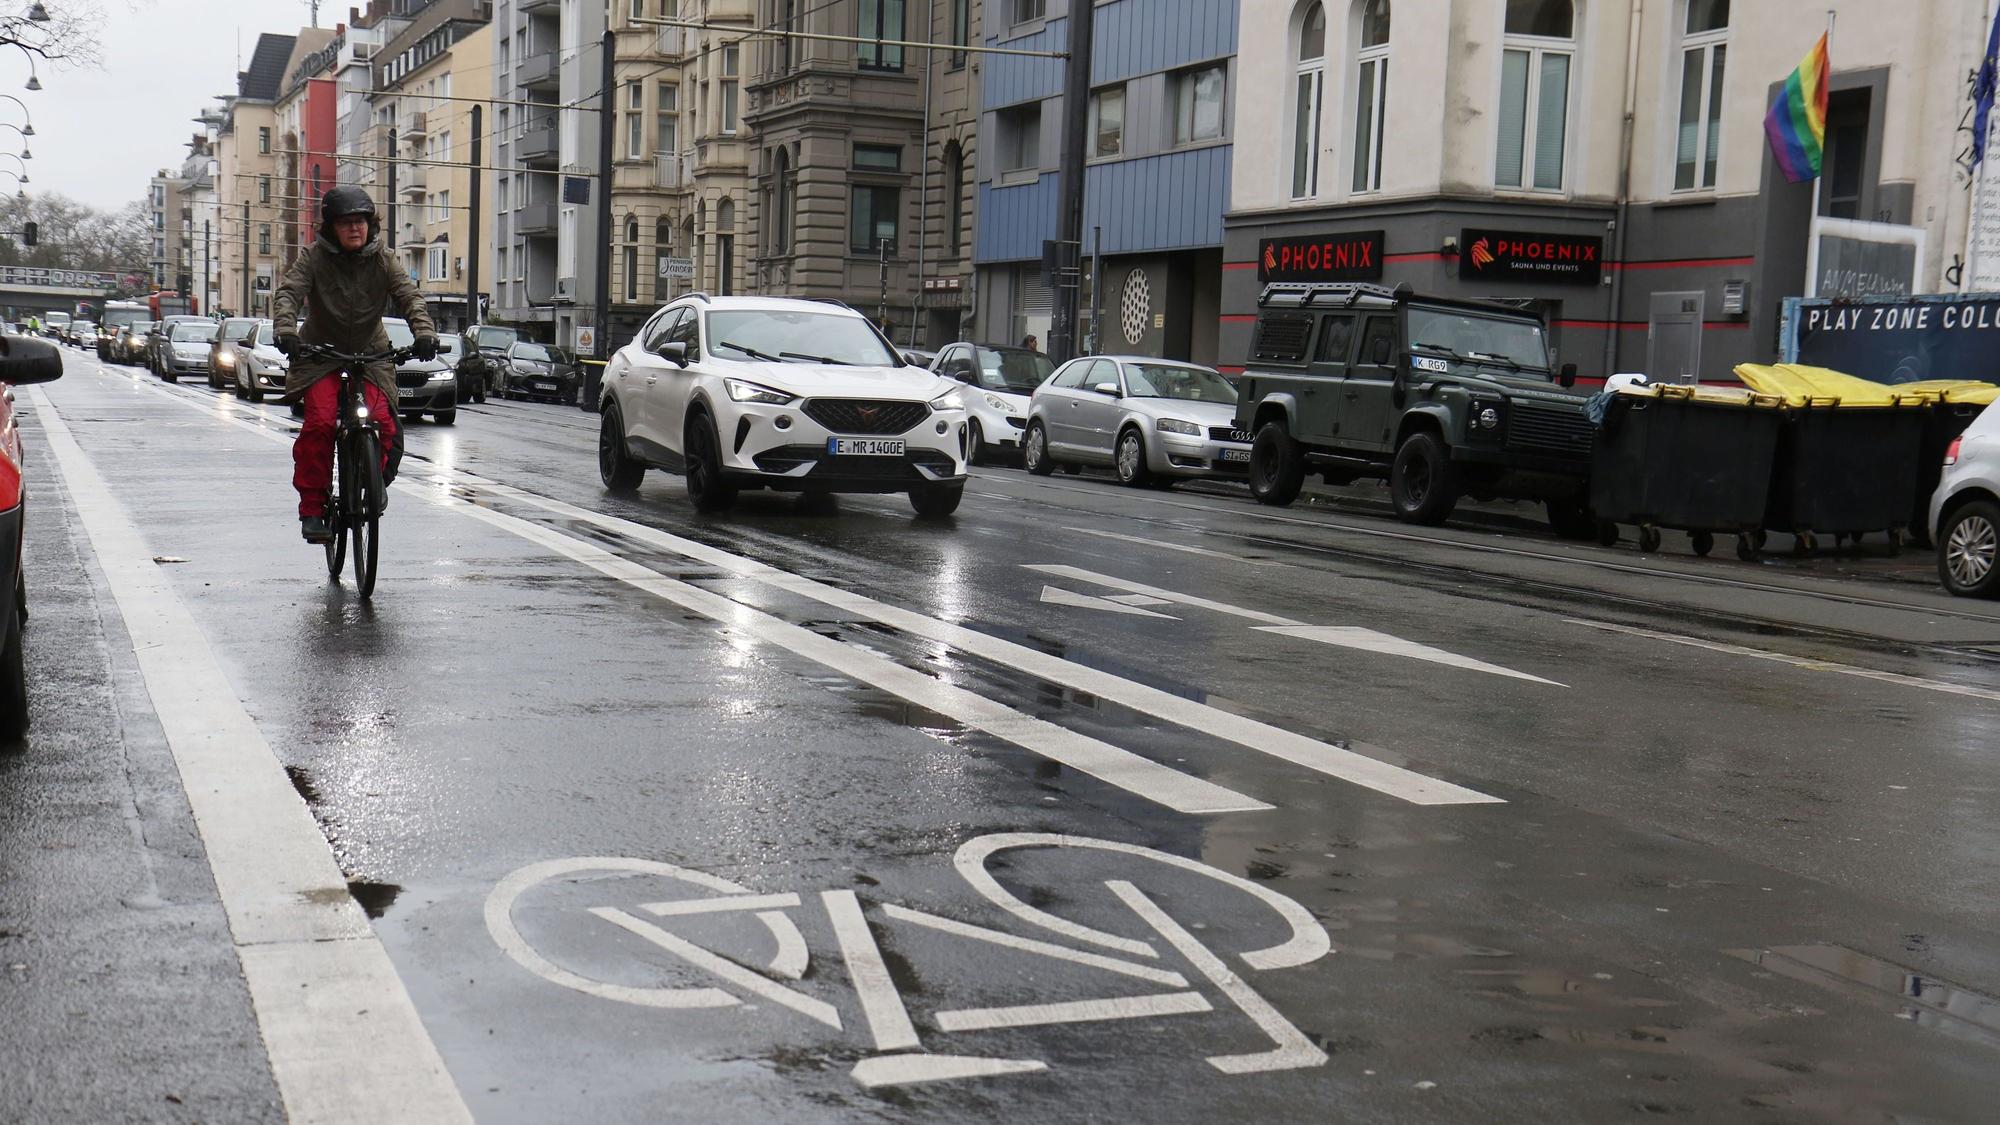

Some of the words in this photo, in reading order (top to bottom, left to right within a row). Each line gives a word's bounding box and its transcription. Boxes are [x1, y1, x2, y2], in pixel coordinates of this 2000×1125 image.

[1281, 241, 1373, 271] PHOENIX
[1497, 240, 1596, 261] PHOENIX
[1552, 264, 1579, 272] EVENTS
[1808, 308, 1862, 331] PLAY
[1870, 306, 1931, 330] ZONE
[1418, 358, 1424, 368] K
[837, 440, 844, 453] E
[852, 441, 867, 454] MR
[869, 441, 903, 455] 1400E
[1225, 450, 1234, 460] SI
